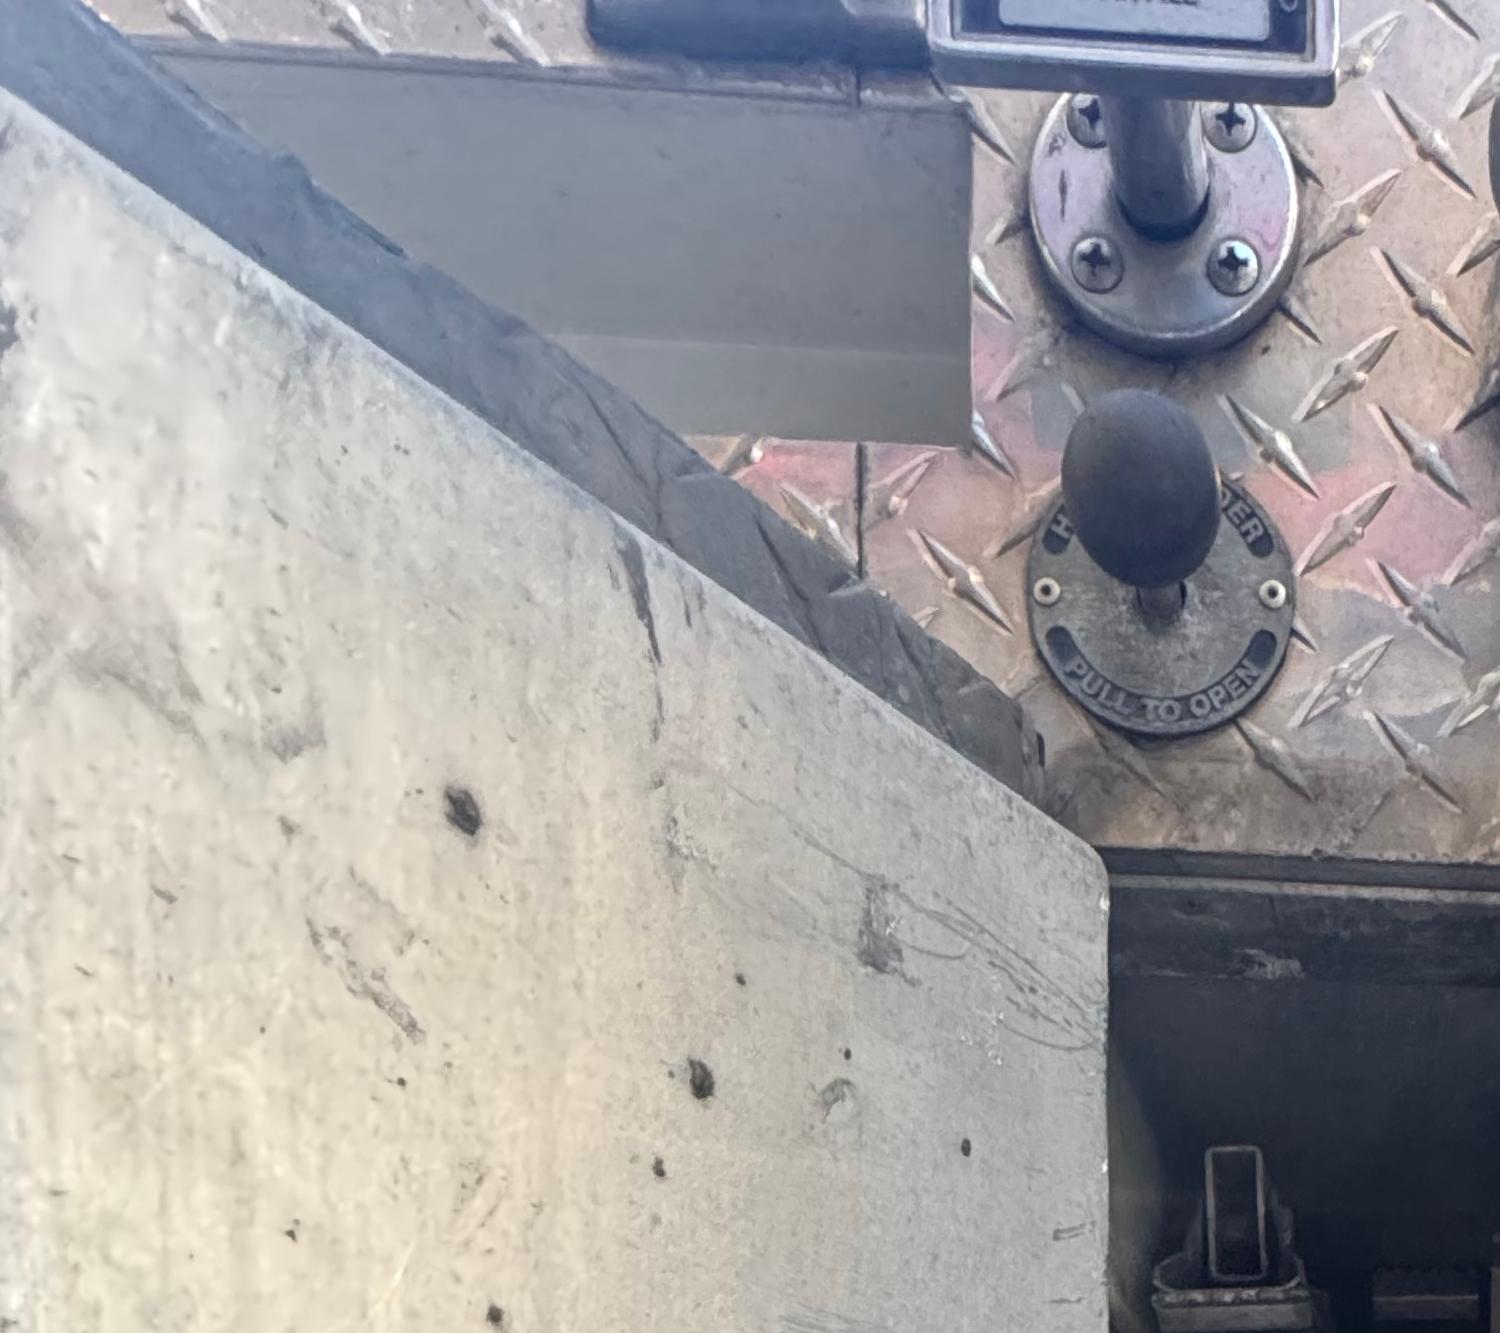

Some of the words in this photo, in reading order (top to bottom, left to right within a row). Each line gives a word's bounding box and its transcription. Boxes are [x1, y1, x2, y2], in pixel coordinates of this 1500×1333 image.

[1064, 659, 1133, 716] PULL
[1142, 697, 1181, 723] TO
[1189, 660, 1261, 718] OPEN
